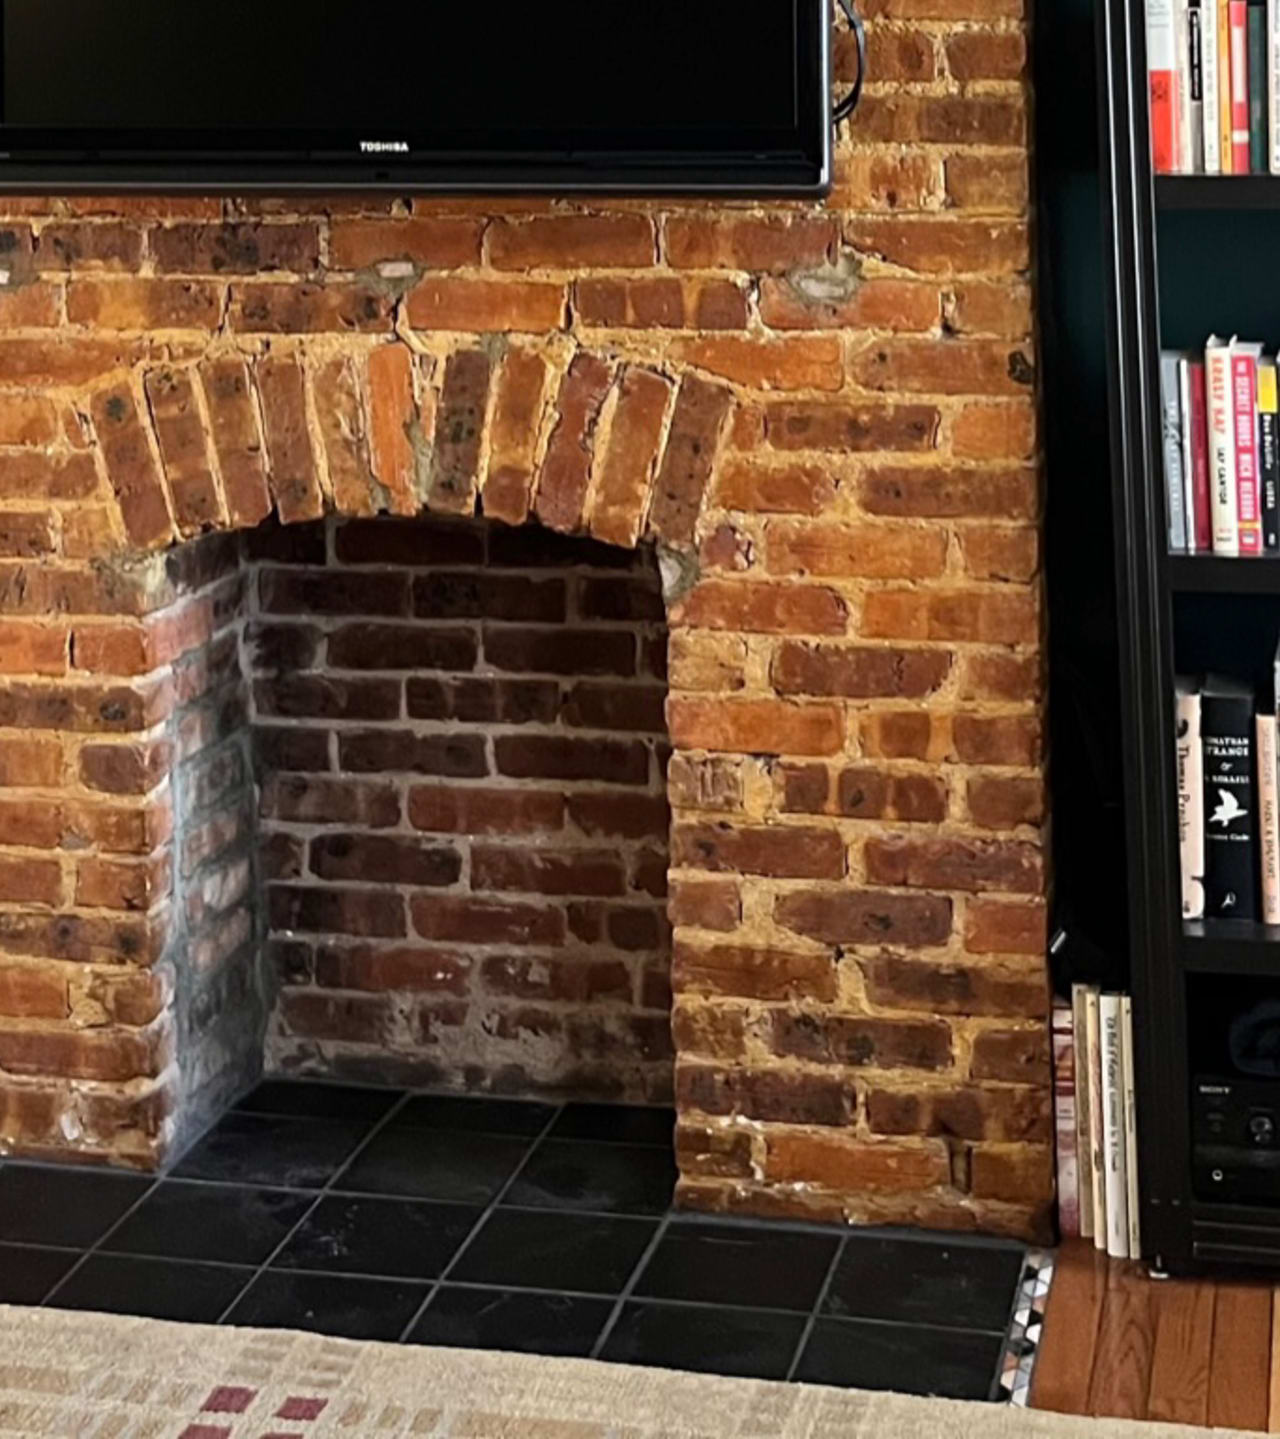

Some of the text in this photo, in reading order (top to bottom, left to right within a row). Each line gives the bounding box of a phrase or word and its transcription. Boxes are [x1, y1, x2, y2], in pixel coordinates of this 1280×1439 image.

[359, 141, 410, 153] TOSHIBA
[1235, 376, 1250, 413] SECRET
[1237, 414, 1252, 448] HOURS
[1239, 453, 1253, 478] MICK
[1206, 746, 1249, 756] TRANGE
[1200, 1086, 1230, 1095] SONY
